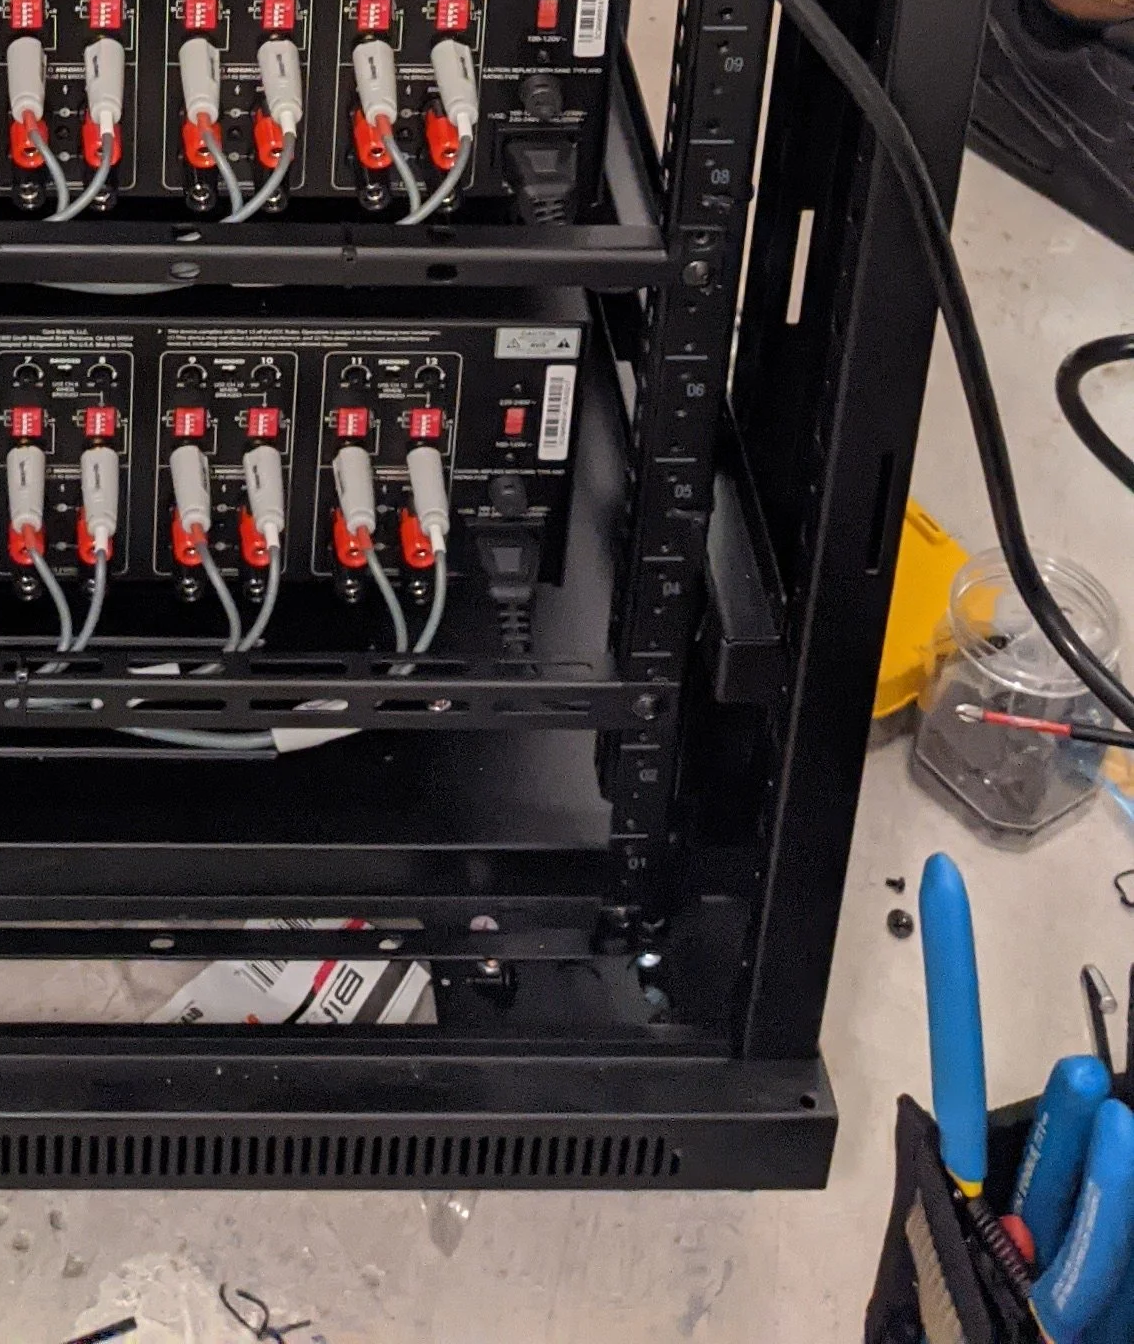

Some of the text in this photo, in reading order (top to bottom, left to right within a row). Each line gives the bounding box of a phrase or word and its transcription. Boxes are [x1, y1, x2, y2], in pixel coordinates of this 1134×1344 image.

[724, 57, 743, 72] 09
[711, 169, 729, 184] 08
[687, 383, 704, 397] 06
[675, 484, 692, 498] 05
[663, 582, 680, 596] 04
[638, 768, 659, 783] 02
[627, 857, 647, 871] 01
